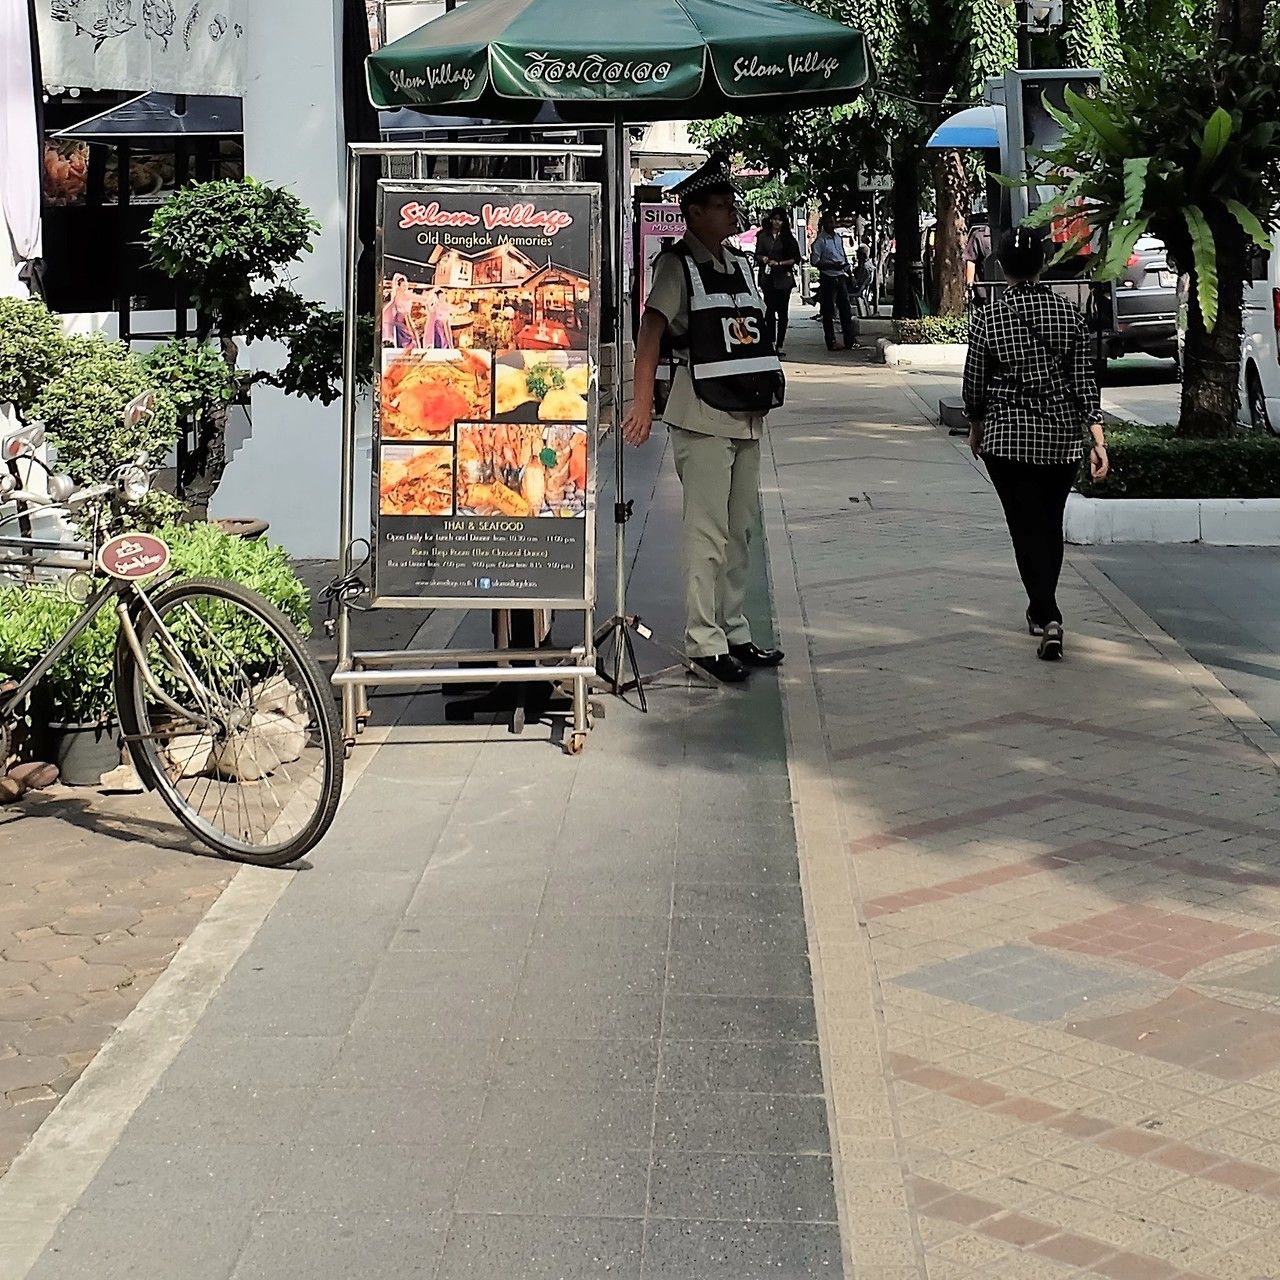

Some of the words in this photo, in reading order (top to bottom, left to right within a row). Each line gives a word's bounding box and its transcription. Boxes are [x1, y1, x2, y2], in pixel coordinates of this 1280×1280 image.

[389, 68, 426, 92] Silom
[426, 63, 476, 91] Village
[733, 55, 785, 82] Silom
[788, 51, 840, 79] Village
[398, 201, 481, 229] Silom
[481, 202, 573, 236] Village
[417, 232, 439, 246] Old
[444, 232, 493, 249] Bangkok
[497, 233, 553, 247] Memories
[443, 521, 465, 531] THAI
[468, 521, 476, 531] &
[478, 521, 524, 532] SEAFOOD
